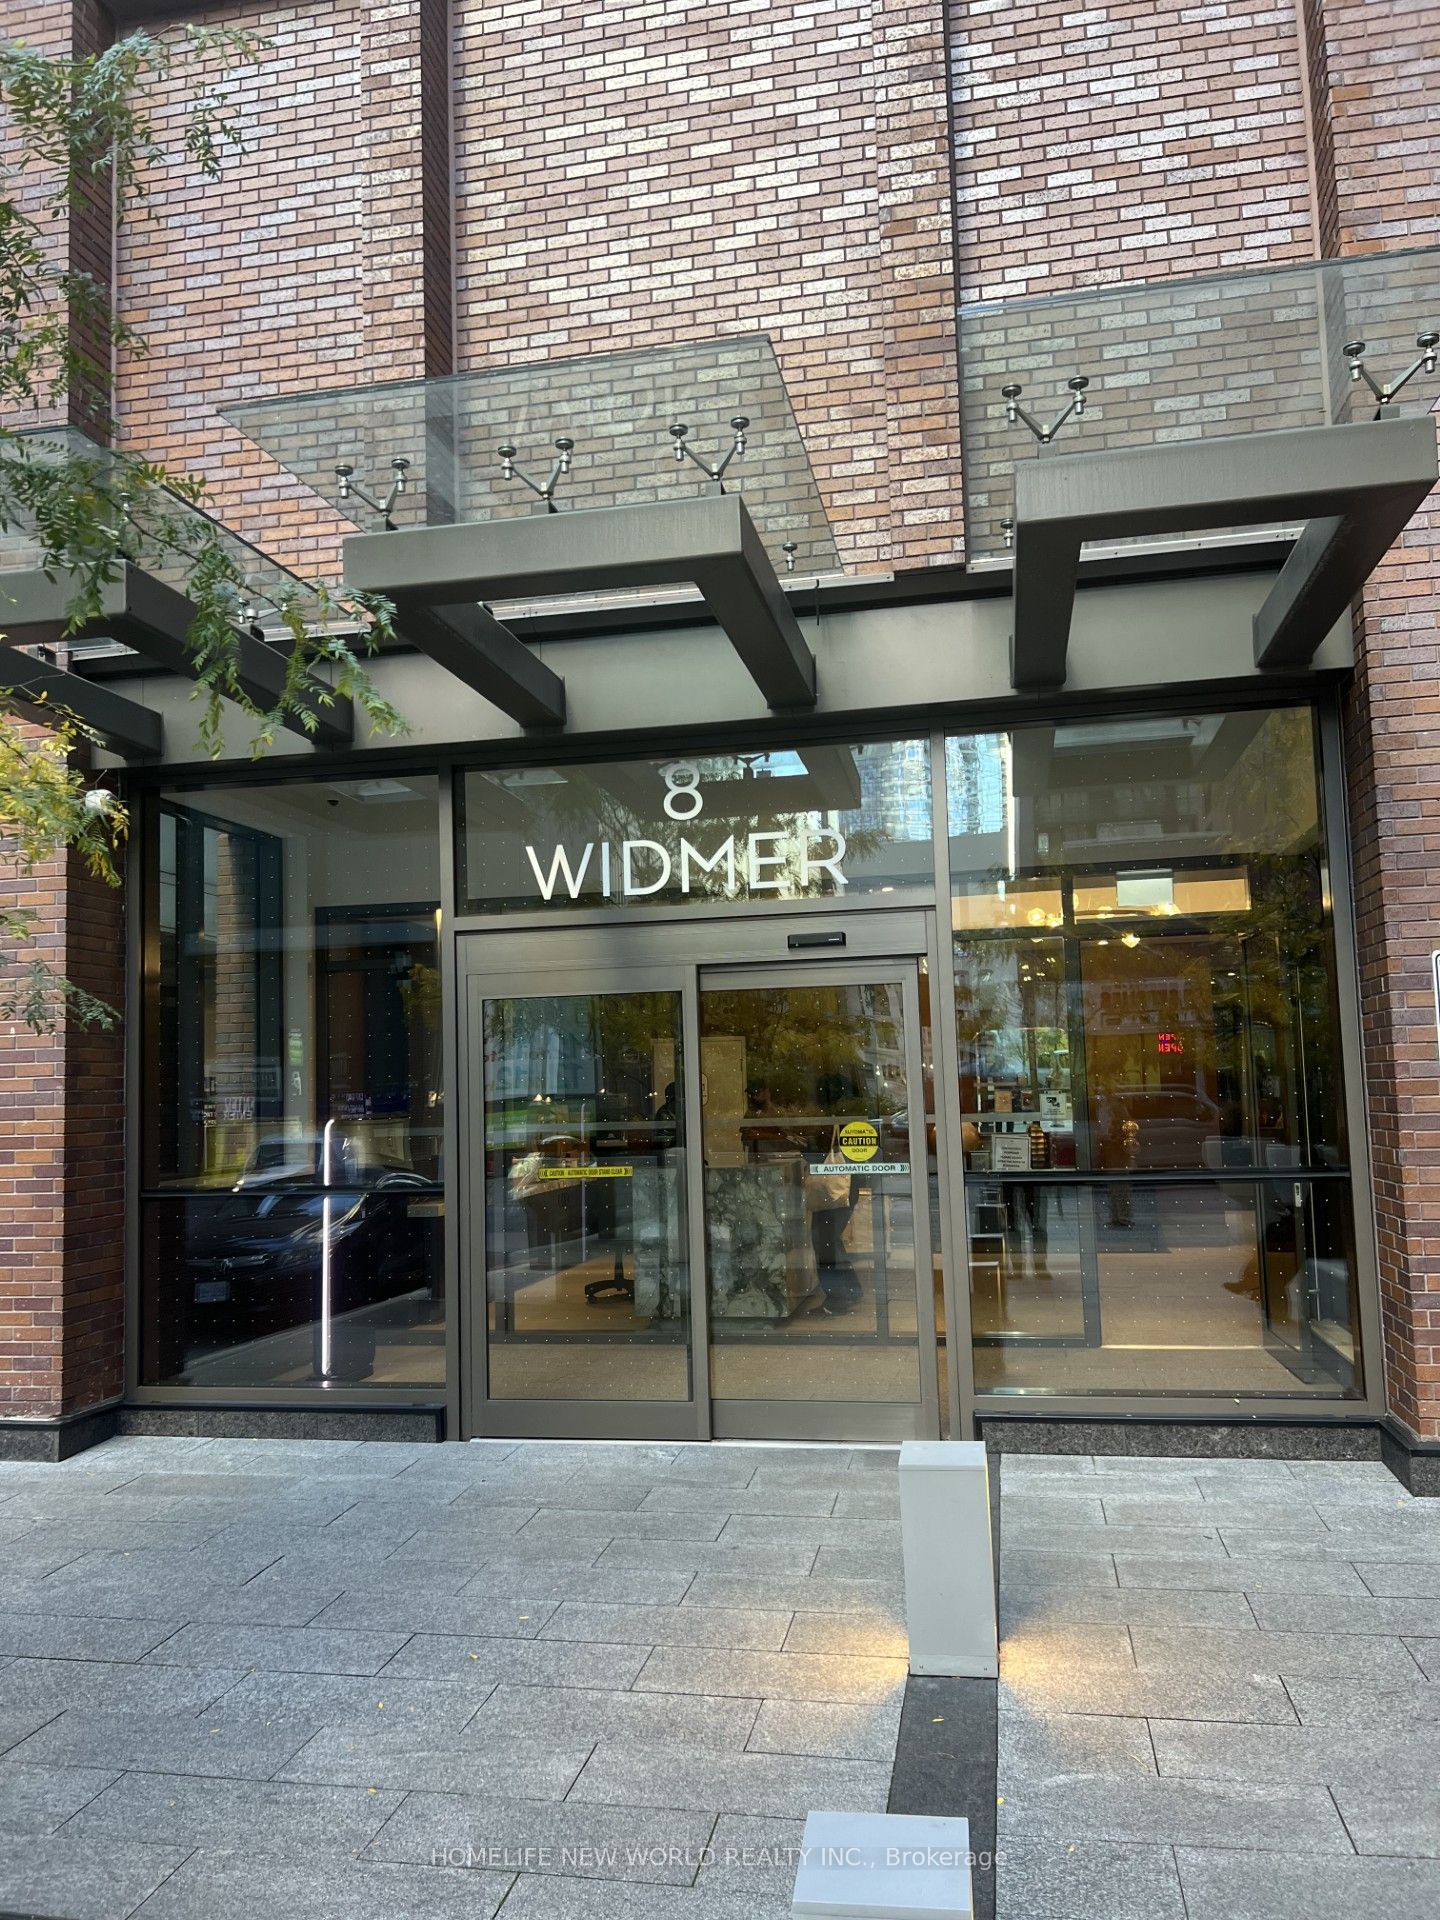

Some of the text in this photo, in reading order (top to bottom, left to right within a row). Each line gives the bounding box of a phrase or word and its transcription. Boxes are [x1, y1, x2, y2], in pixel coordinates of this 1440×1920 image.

[663, 763, 703, 820] 8
[525, 827, 848, 900] WIDMER
[842, 1137, 877, 1145] CAUTION
[567, 1168, 588, 1176] AUTOMATIC
[823, 1163, 896, 1172] AUTOMATIC DOOR
